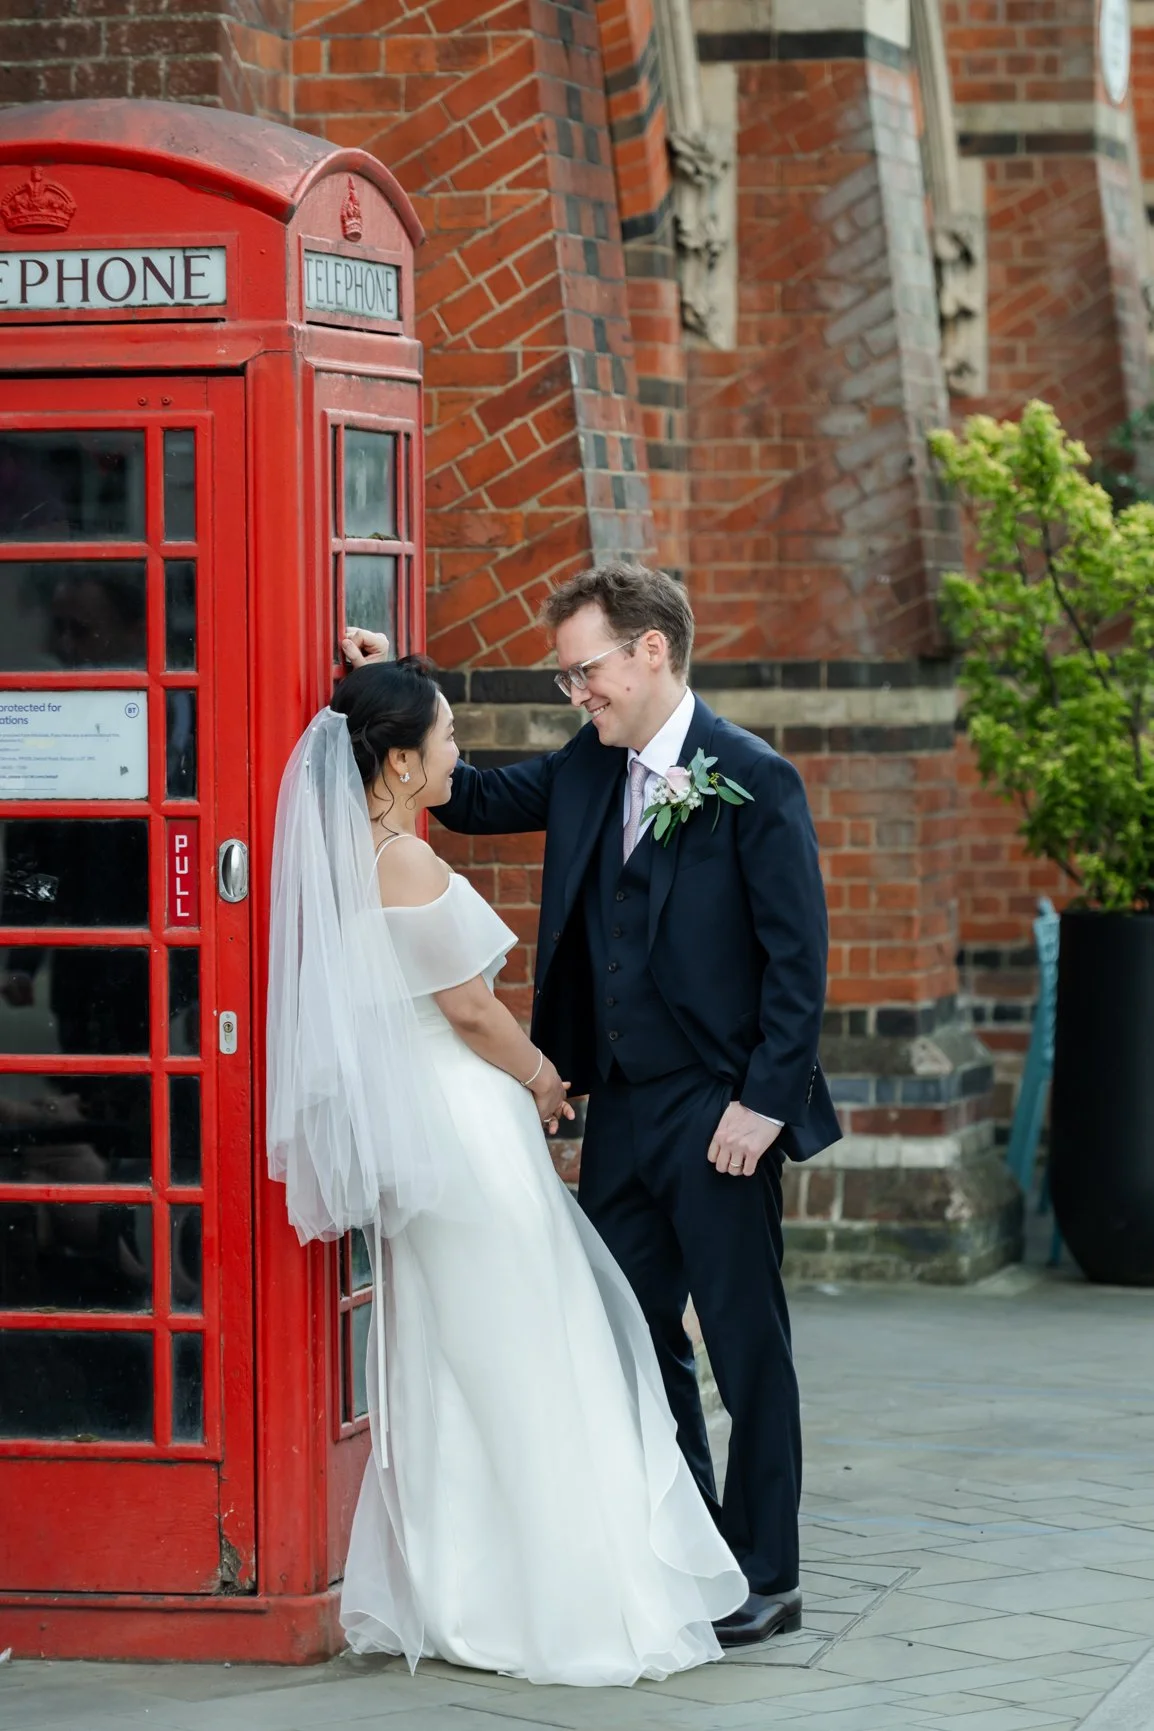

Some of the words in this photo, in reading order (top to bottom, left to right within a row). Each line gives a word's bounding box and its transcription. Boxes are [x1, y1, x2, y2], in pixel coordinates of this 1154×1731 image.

[305, 258, 393, 313] TELEPHONE
[48, 703, 62, 712] for
[175, 834, 190, 917] PULL
